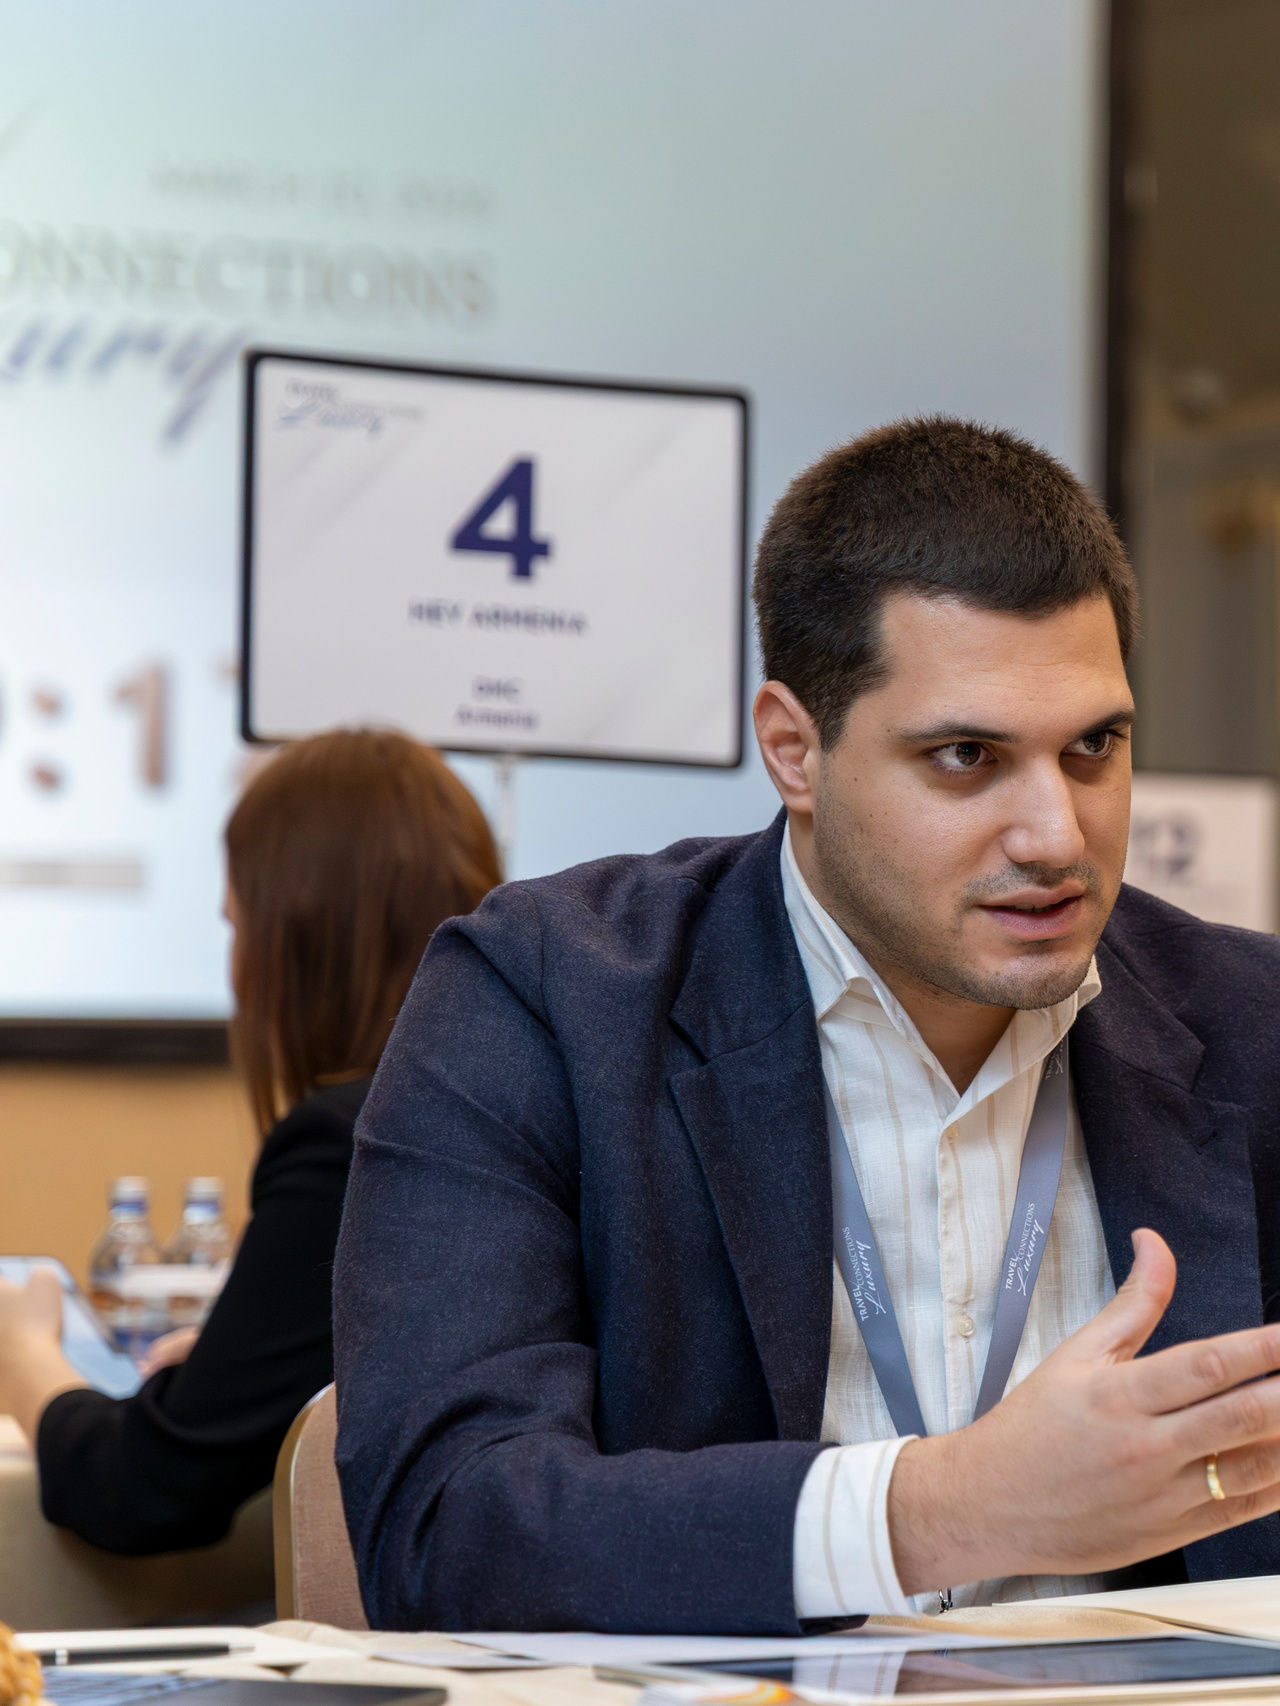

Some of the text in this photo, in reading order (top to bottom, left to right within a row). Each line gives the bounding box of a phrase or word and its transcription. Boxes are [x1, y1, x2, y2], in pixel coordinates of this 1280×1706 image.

[450, 458, 551, 581] 4
[842, 1226, 865, 1286] CONNECTIONS
[1016, 1219, 1045, 1297] Luxury
[1018, 1202, 1035, 1260] CONNECTIONS
[852, 1284, 869, 1322] TRAVEL
[855, 1240, 887, 1315] Luxury
[1005, 1257, 1018, 1290] TRAVEL
